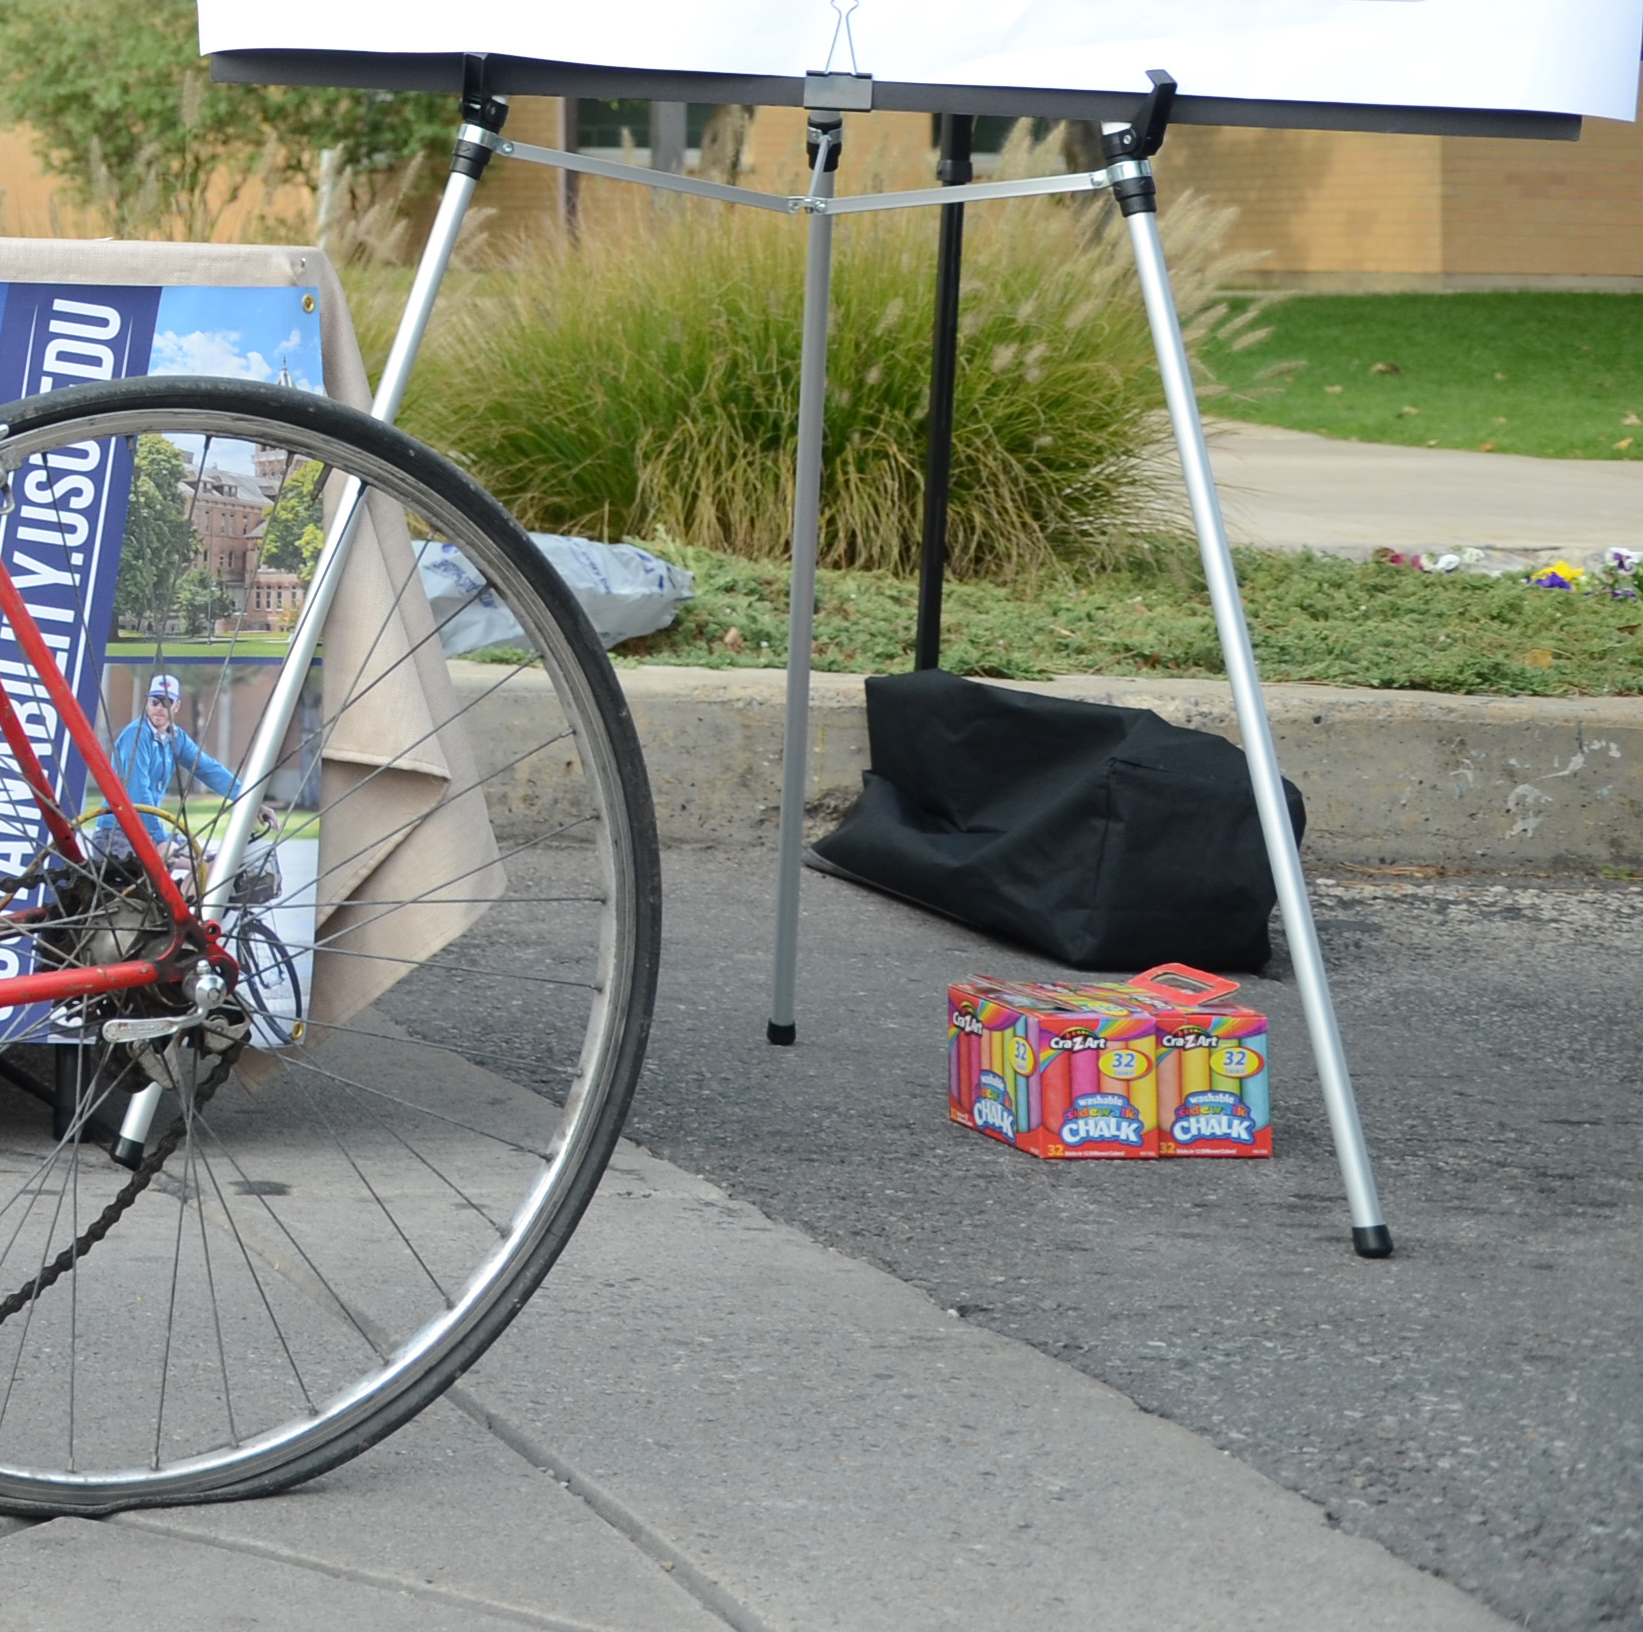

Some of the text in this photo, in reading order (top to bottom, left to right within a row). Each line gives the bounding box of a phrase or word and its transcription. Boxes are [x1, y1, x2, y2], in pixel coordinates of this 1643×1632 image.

[1112, 1053, 1136, 1068] 32
[1223, 1051, 1246, 1066] 32
[1078, 1096, 1123, 1106] washable
[1189, 1094, 1234, 1104] washable
[974, 1100, 1014, 1139] CHALK
[1062, 1119, 1143, 1143] CHALK
[1174, 1118, 1252, 1142] CHALK
[1048, 1145, 1063, 1157] 32
[1160, 1142, 1175, 1154] 32
